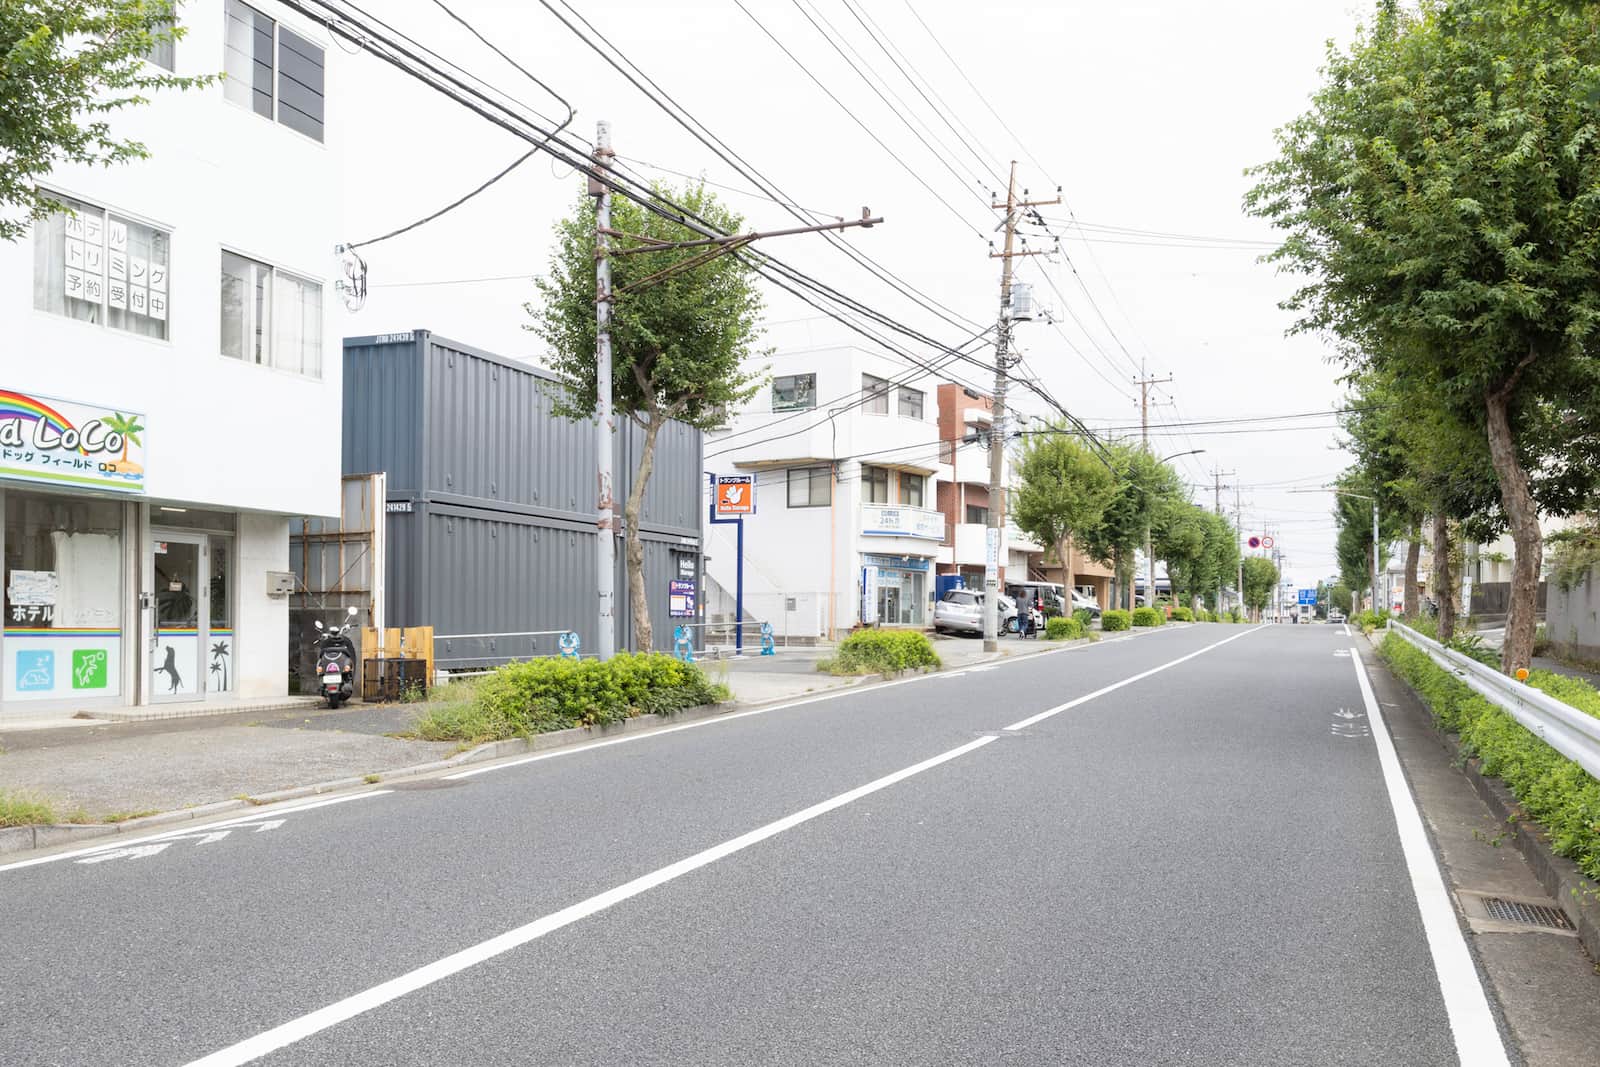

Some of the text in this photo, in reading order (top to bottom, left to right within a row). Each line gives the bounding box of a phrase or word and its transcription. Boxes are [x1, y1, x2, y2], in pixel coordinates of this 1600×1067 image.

[68, 216, 125, 244] ホテル
[70, 244, 164, 284] トリミング
[67, 274, 165, 313] 予約受付中
[33, 416, 124, 453] LoCo
[3, 449, 117, 473] ドッグ フィールド ロコ
[12, 605, 54, 622] ホテル
